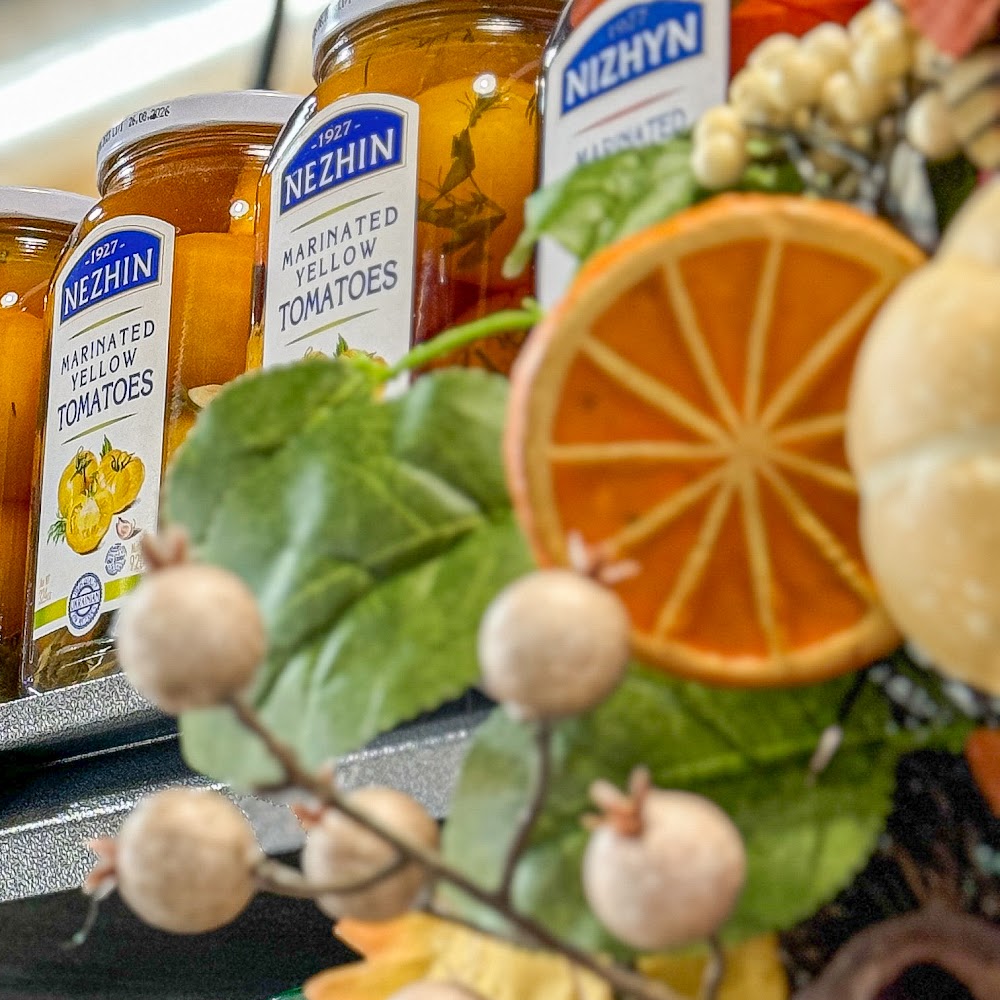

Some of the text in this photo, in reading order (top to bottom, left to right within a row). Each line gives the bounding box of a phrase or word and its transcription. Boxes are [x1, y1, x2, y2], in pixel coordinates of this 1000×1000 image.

[565, 11, 698, 106] NIZHYN
[284, 128, 394, 206] NEZHIN
[282, 206, 399, 271] MARINATED
[296, 237, 378, 288] YELLOW
[64, 248, 153, 316] NEZHIN
[279, 260, 398, 332] TOMATOES
[61, 320, 155, 376] MARINATED
[71, 348, 138, 392] YELLOW
[57, 368, 154, 432] TOMATOES
